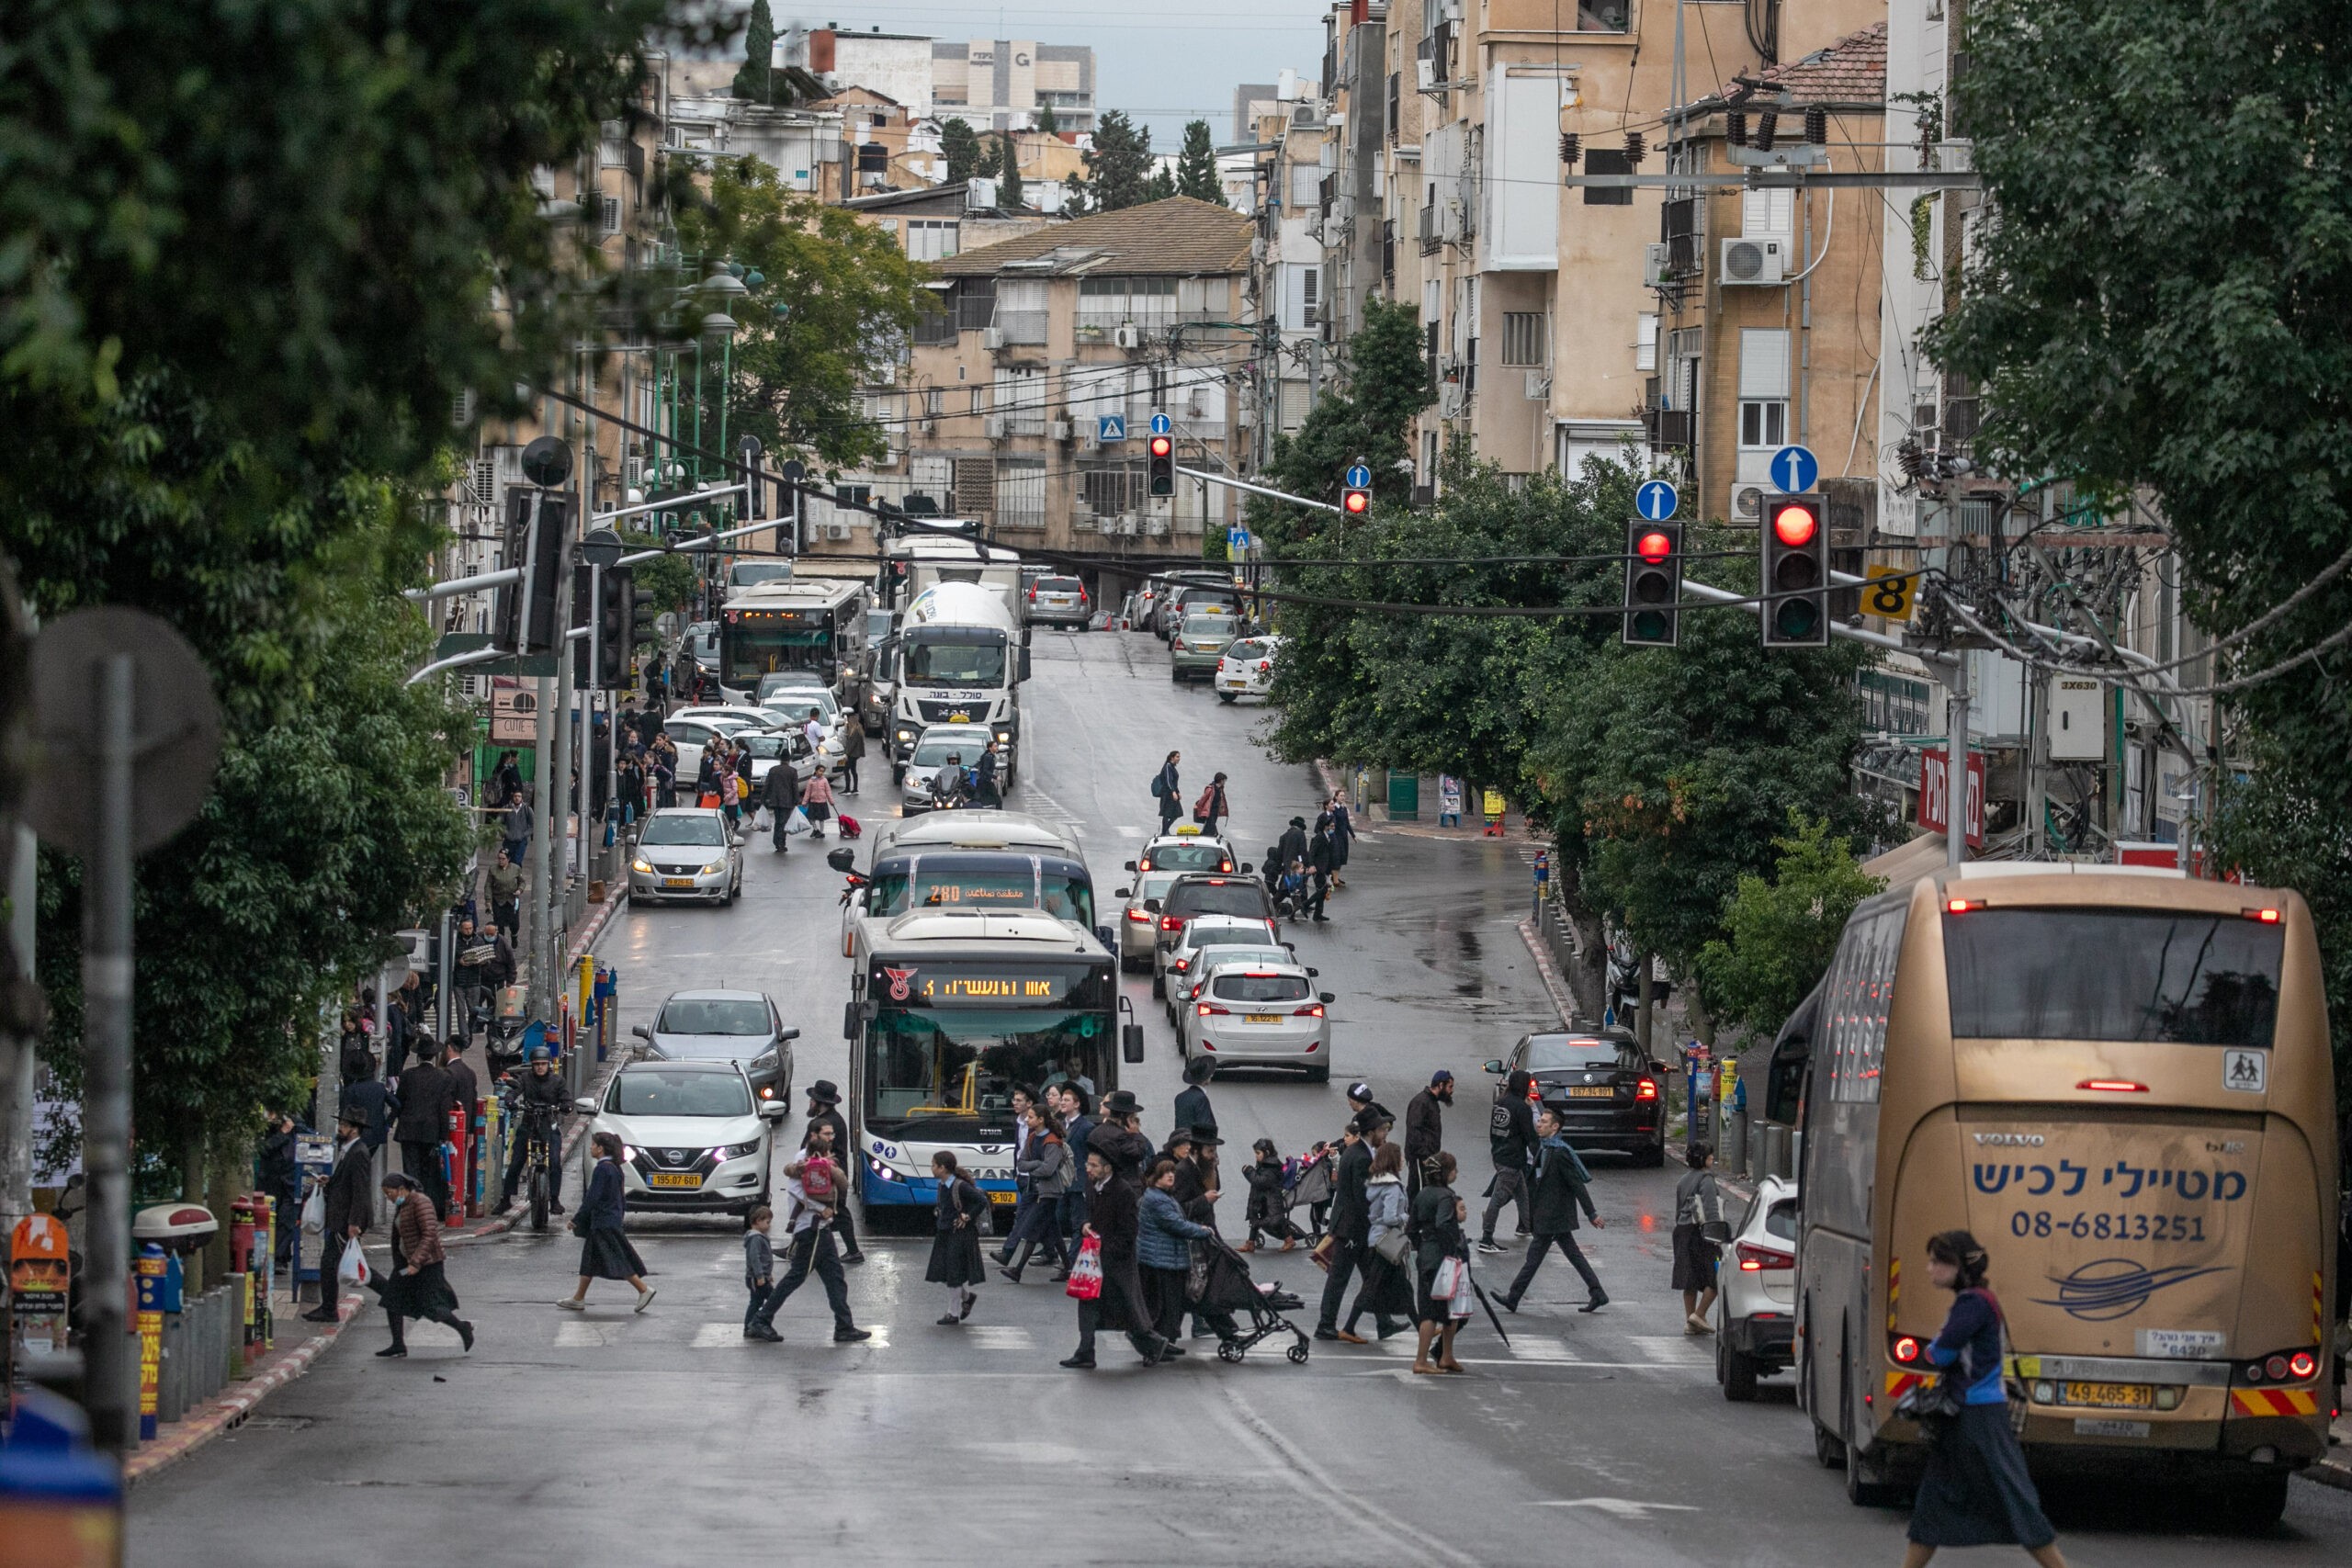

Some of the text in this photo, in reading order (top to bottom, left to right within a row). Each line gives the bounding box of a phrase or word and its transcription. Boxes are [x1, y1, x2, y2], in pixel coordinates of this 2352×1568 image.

[1872, 573, 1907, 614] 8
[2061, 681, 2098, 690] 3X630
[930, 885, 960, 902] 280
[1973, 1133, 2045, 1148] VOLVO
[1973, 1158, 2247, 1201] מטיילי לכיש
[2011, 1210, 2206, 1242] 08-6813251
